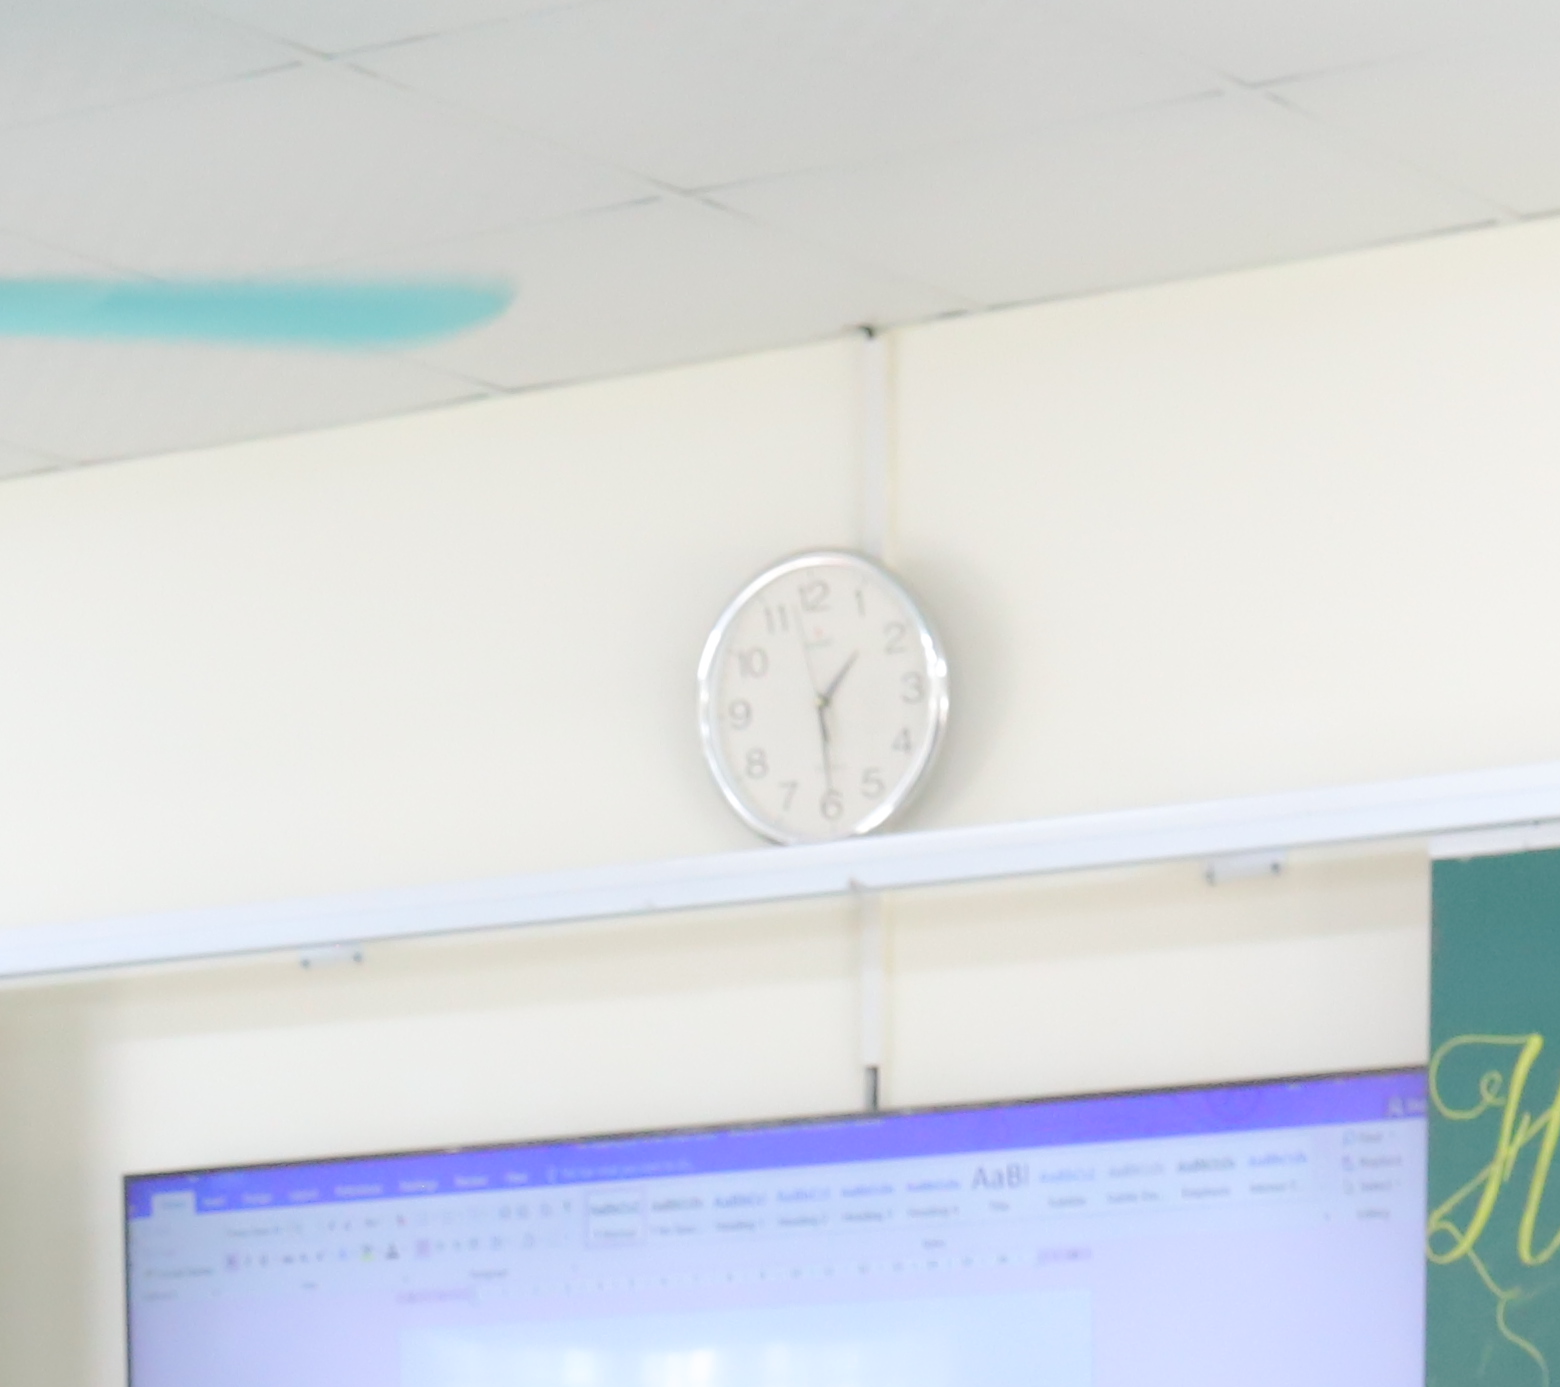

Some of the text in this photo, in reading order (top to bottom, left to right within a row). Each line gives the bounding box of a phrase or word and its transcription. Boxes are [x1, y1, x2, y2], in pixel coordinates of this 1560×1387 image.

[797, 578, 831, 612] 12
[854, 588, 866, 617] 1
[764, 604, 790, 634] 11
[884, 622, 907, 655] 2
[737, 646, 769, 679] 10
[900, 671, 926, 704] 3
[727, 698, 753, 731] 9
[891, 728, 913, 756] 4
[744, 747, 769, 780] 8
[780, 780, 799, 813] 7
[861, 767, 886, 799] 5
[818, 787, 844, 821] 6
[970, 1163, 1030, 1191] AaB
